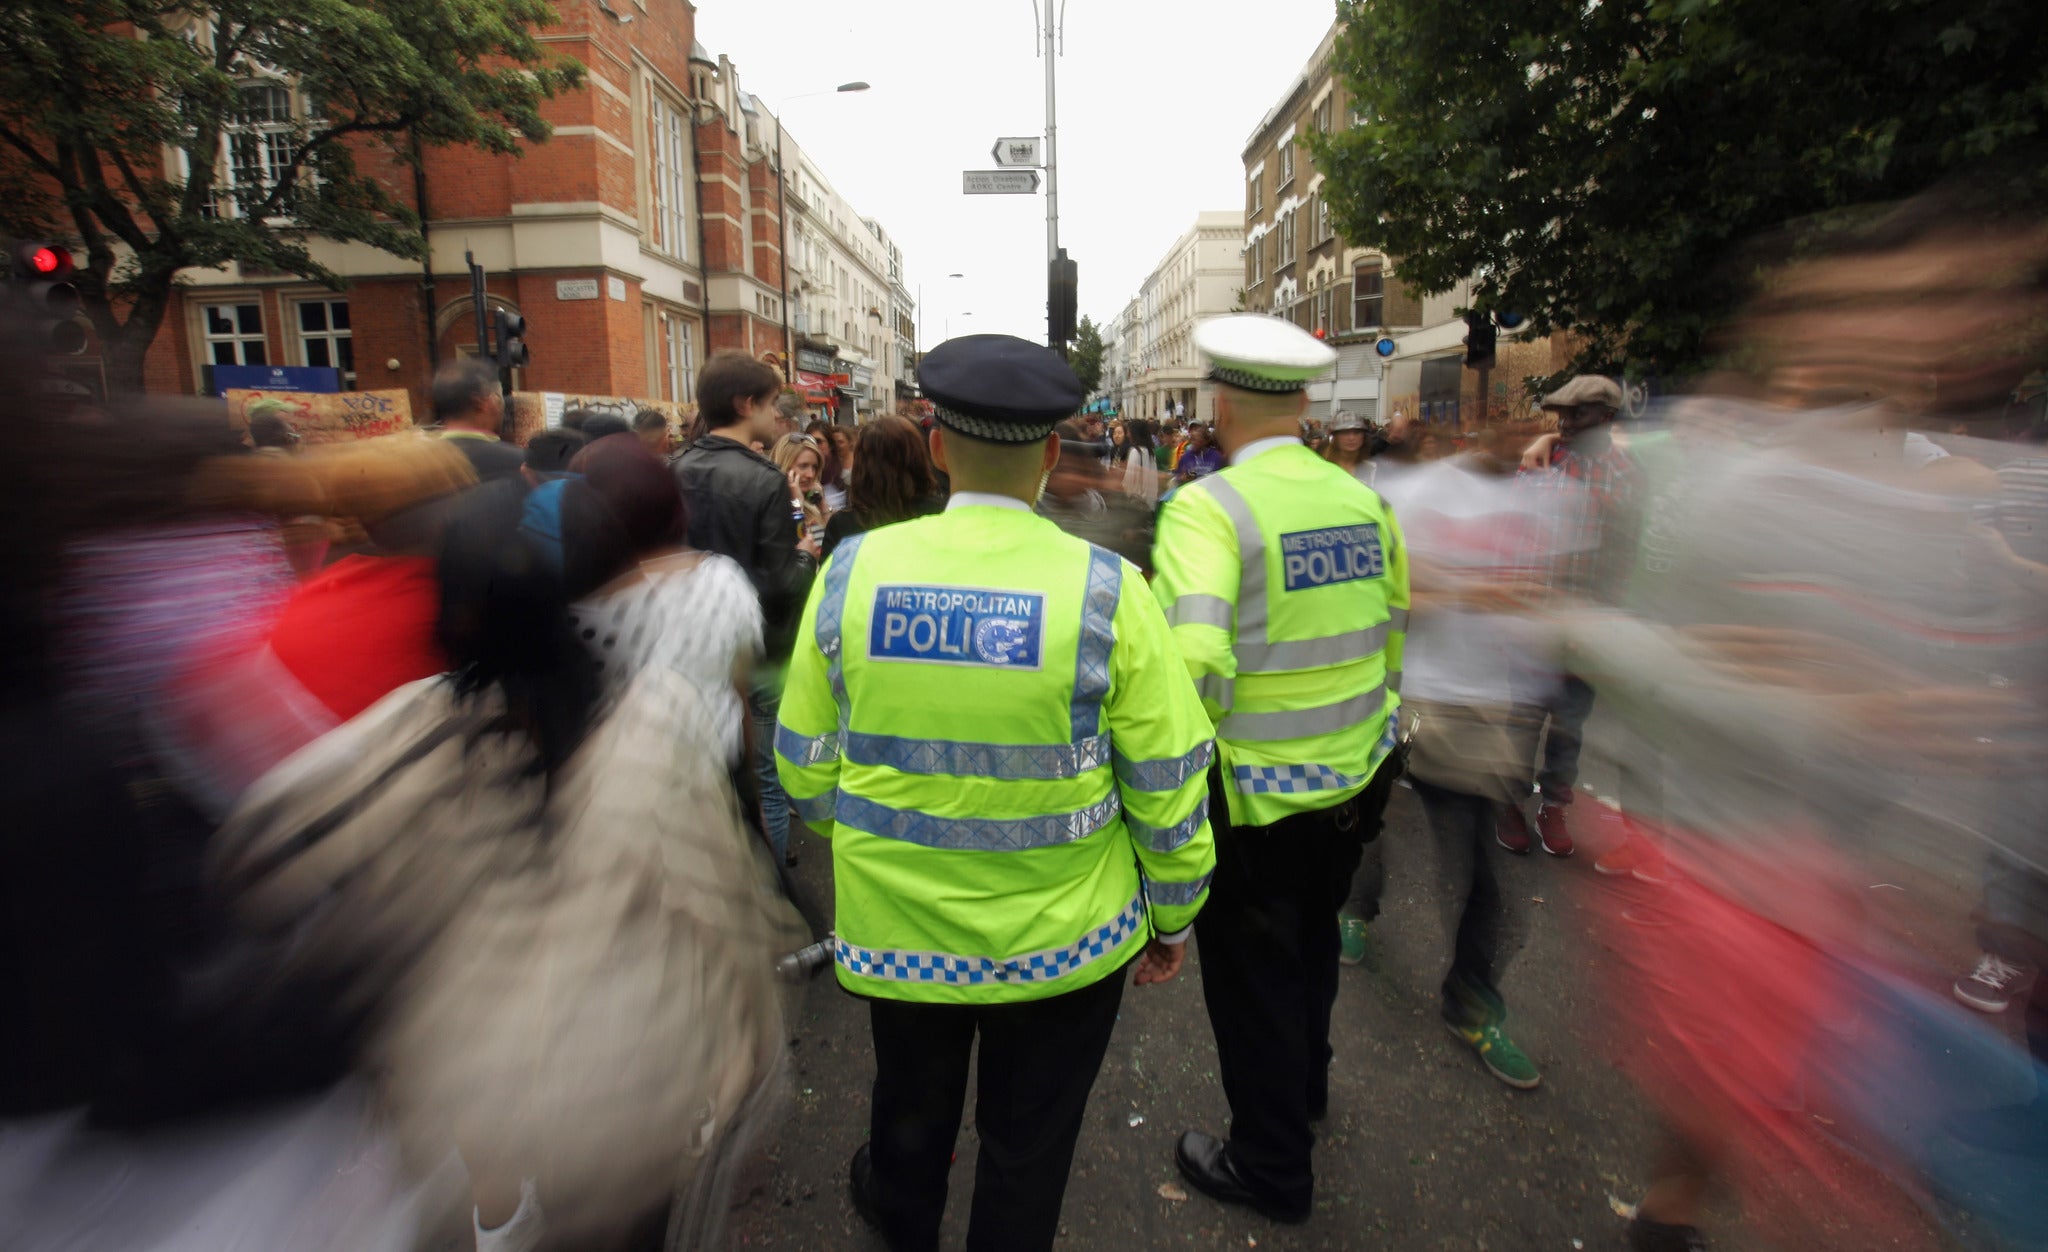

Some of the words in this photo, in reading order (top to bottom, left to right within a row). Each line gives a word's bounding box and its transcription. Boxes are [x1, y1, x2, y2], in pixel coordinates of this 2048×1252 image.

[1283, 527, 1377, 553] METROPOLITAN
[1286, 544, 1384, 587] POLICE
[886, 590, 1031, 617] METROPOLITAN
